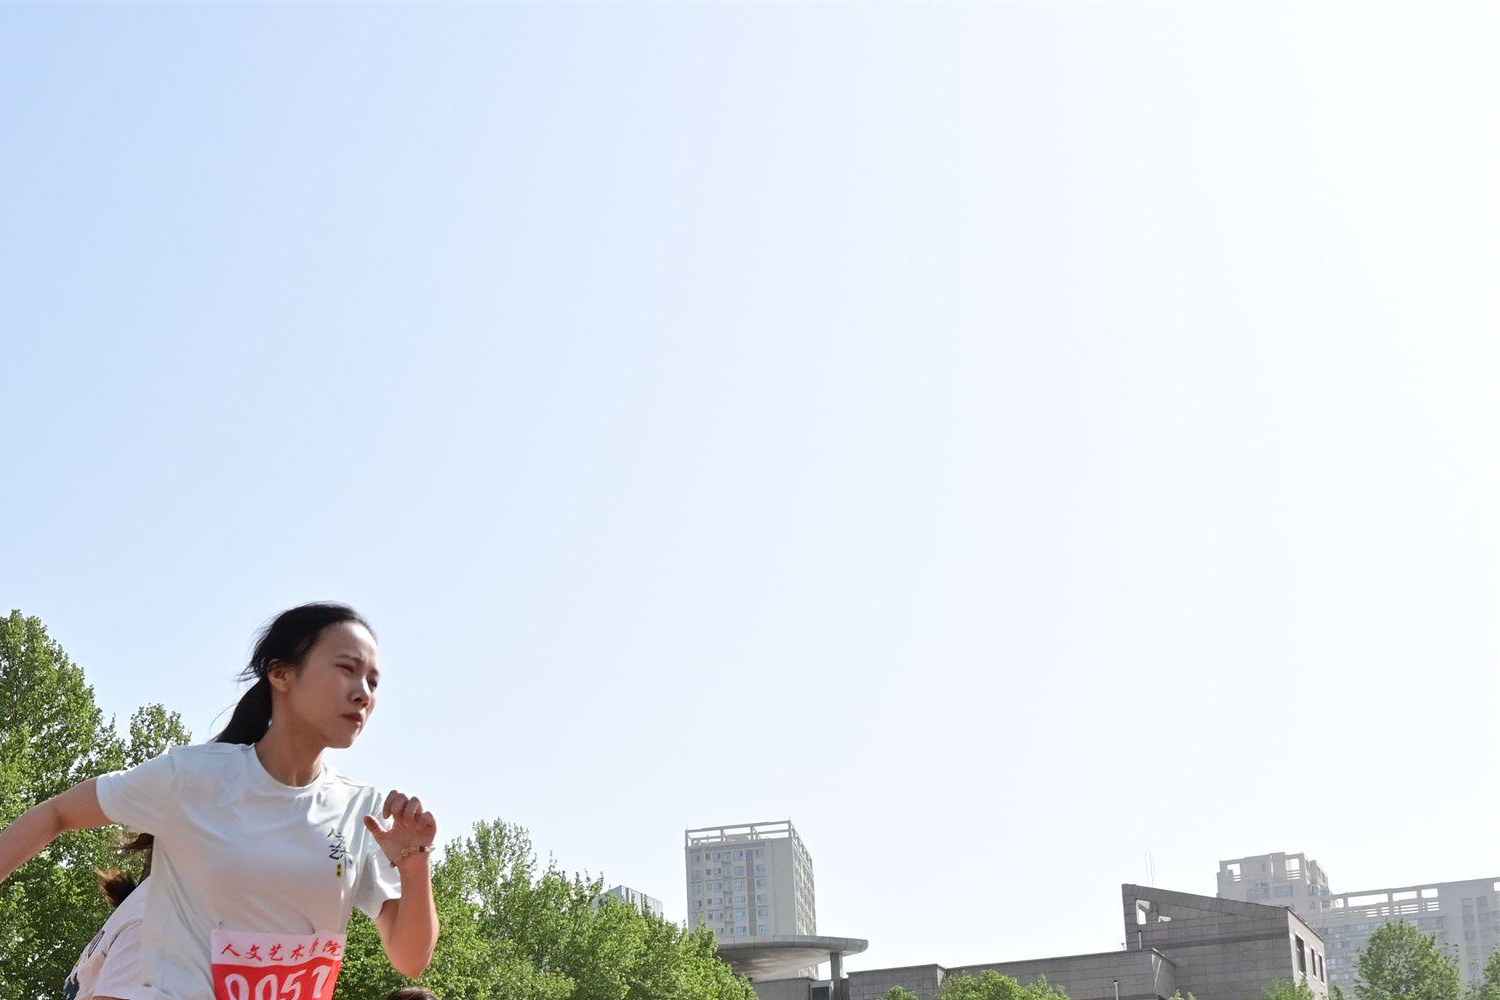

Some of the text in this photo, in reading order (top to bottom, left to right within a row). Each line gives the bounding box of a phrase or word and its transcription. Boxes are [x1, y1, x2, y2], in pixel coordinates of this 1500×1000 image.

[221, 938, 342, 961] 人文艺术学院
